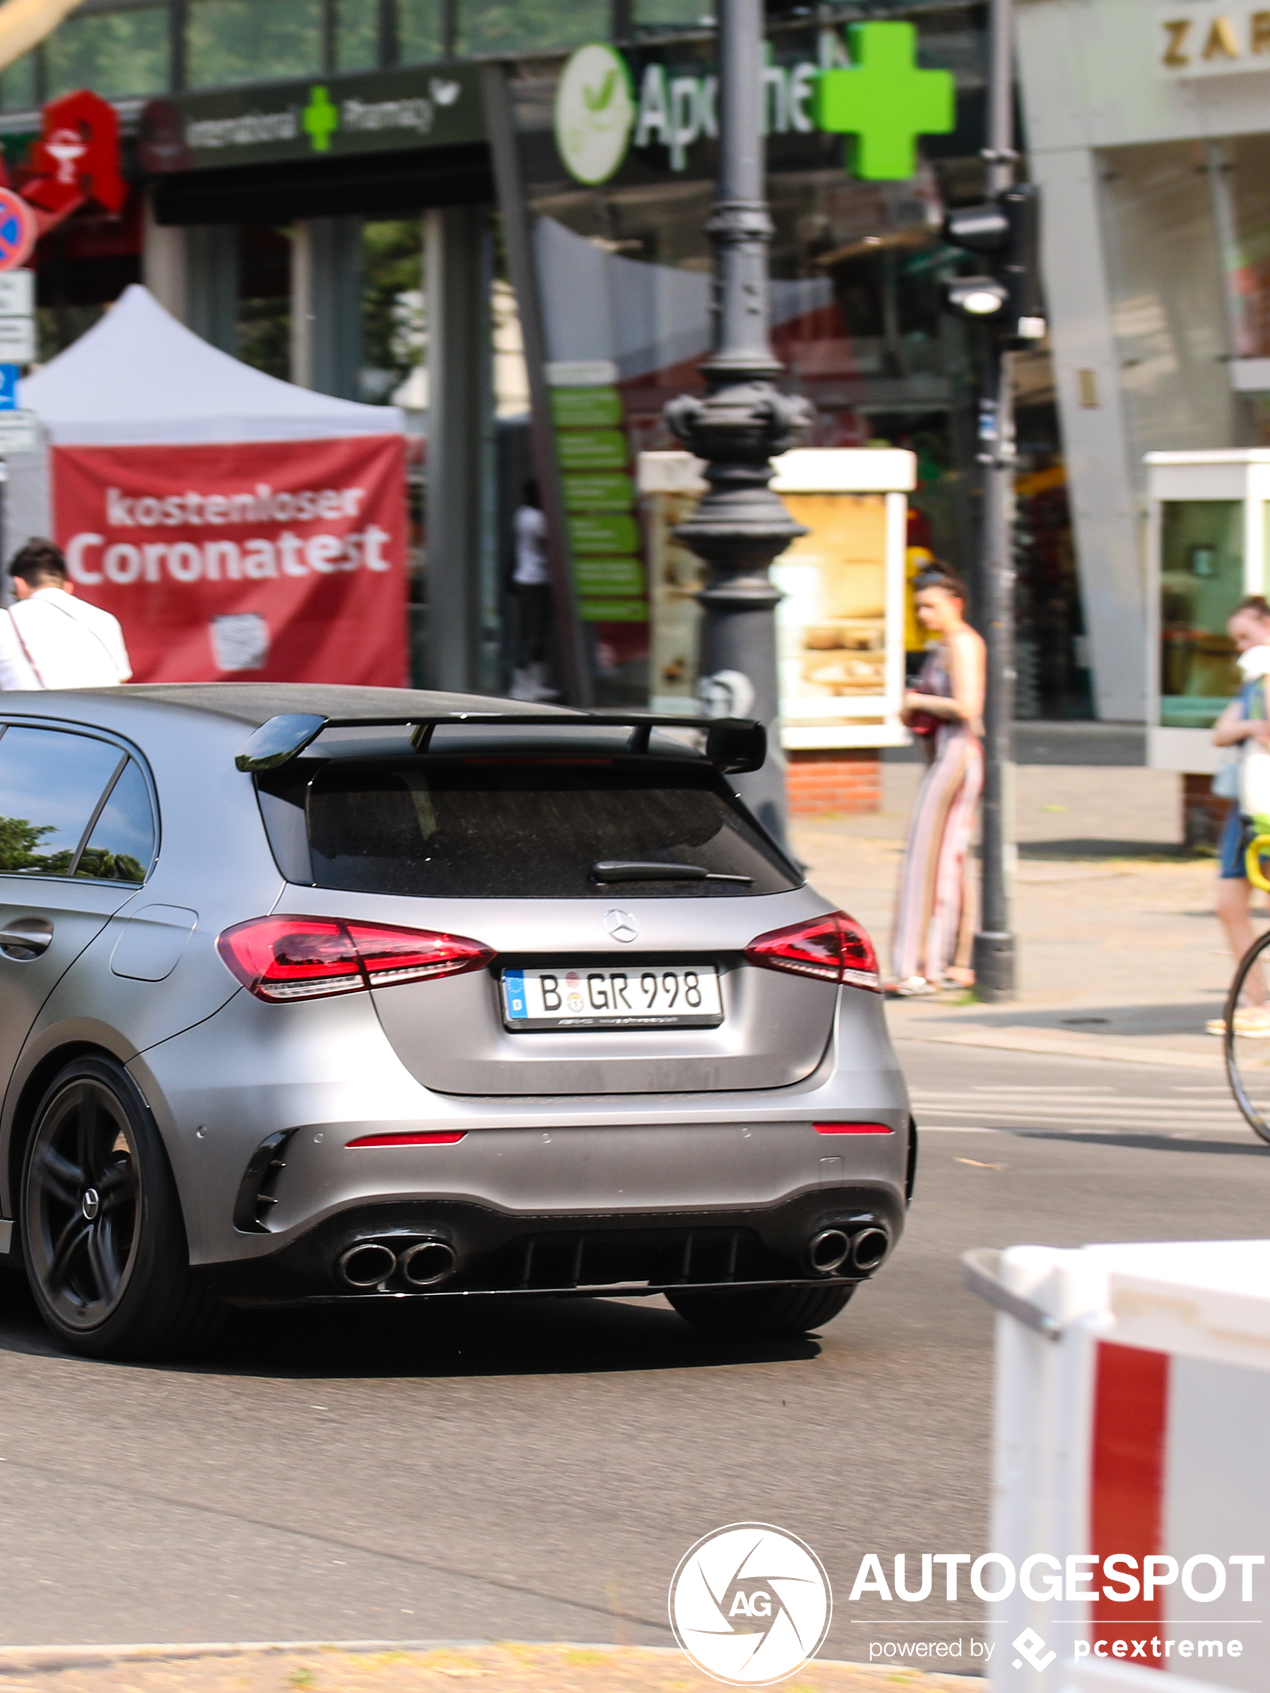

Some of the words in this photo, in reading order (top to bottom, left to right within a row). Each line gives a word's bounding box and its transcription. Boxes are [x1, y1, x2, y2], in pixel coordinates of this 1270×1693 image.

[106, 484, 365, 528] kostenloser
[67, 525, 393, 586] Coronatest
[540, 974, 562, 1011] B
[587, 971, 632, 1010] GR
[641, 971, 702, 1008] 998
